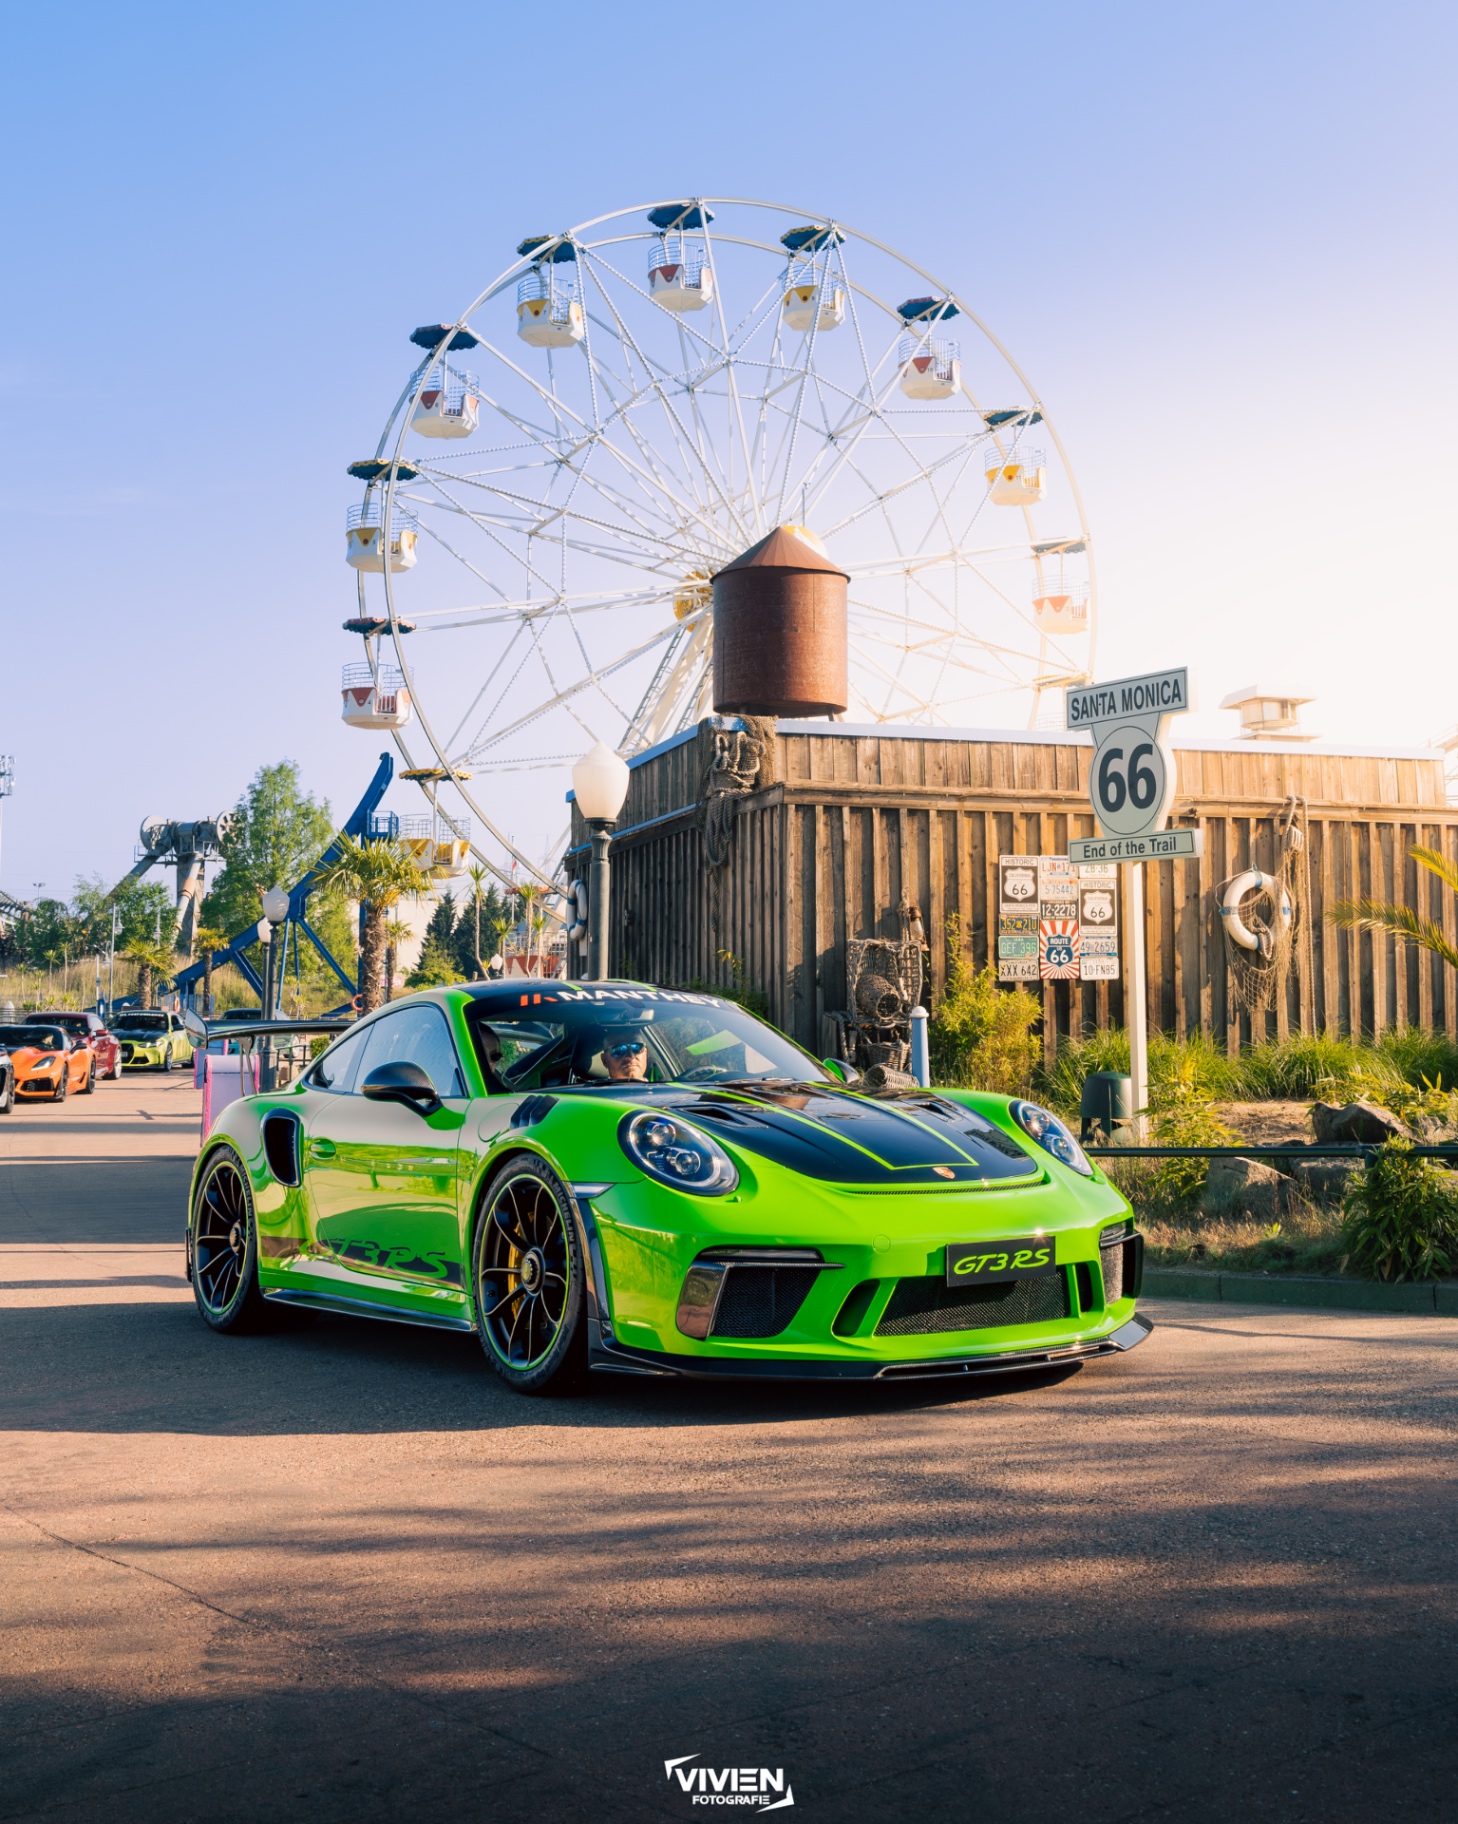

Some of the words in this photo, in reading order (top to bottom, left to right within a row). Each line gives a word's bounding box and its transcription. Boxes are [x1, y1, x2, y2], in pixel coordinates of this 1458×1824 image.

[1072, 691, 1116, 721] SANTA
[1122, 678, 1182, 712] MONICA
[1098, 743, 1156, 812] 66
[1084, 842, 1106, 858] End
[1110, 841, 1122, 856] of
[1126, 839, 1145, 855] the
[1149, 836, 1176, 852] Trail
[1012, 884, 1028, 896] 66
[1090, 906, 1106, 918] 66
[1050, 950, 1068, 963] 66
[1022, 964, 1036, 976] 642
[556, 990, 720, 1008] MANTHEY
[552, 1182, 576, 1244] MICHELIN
